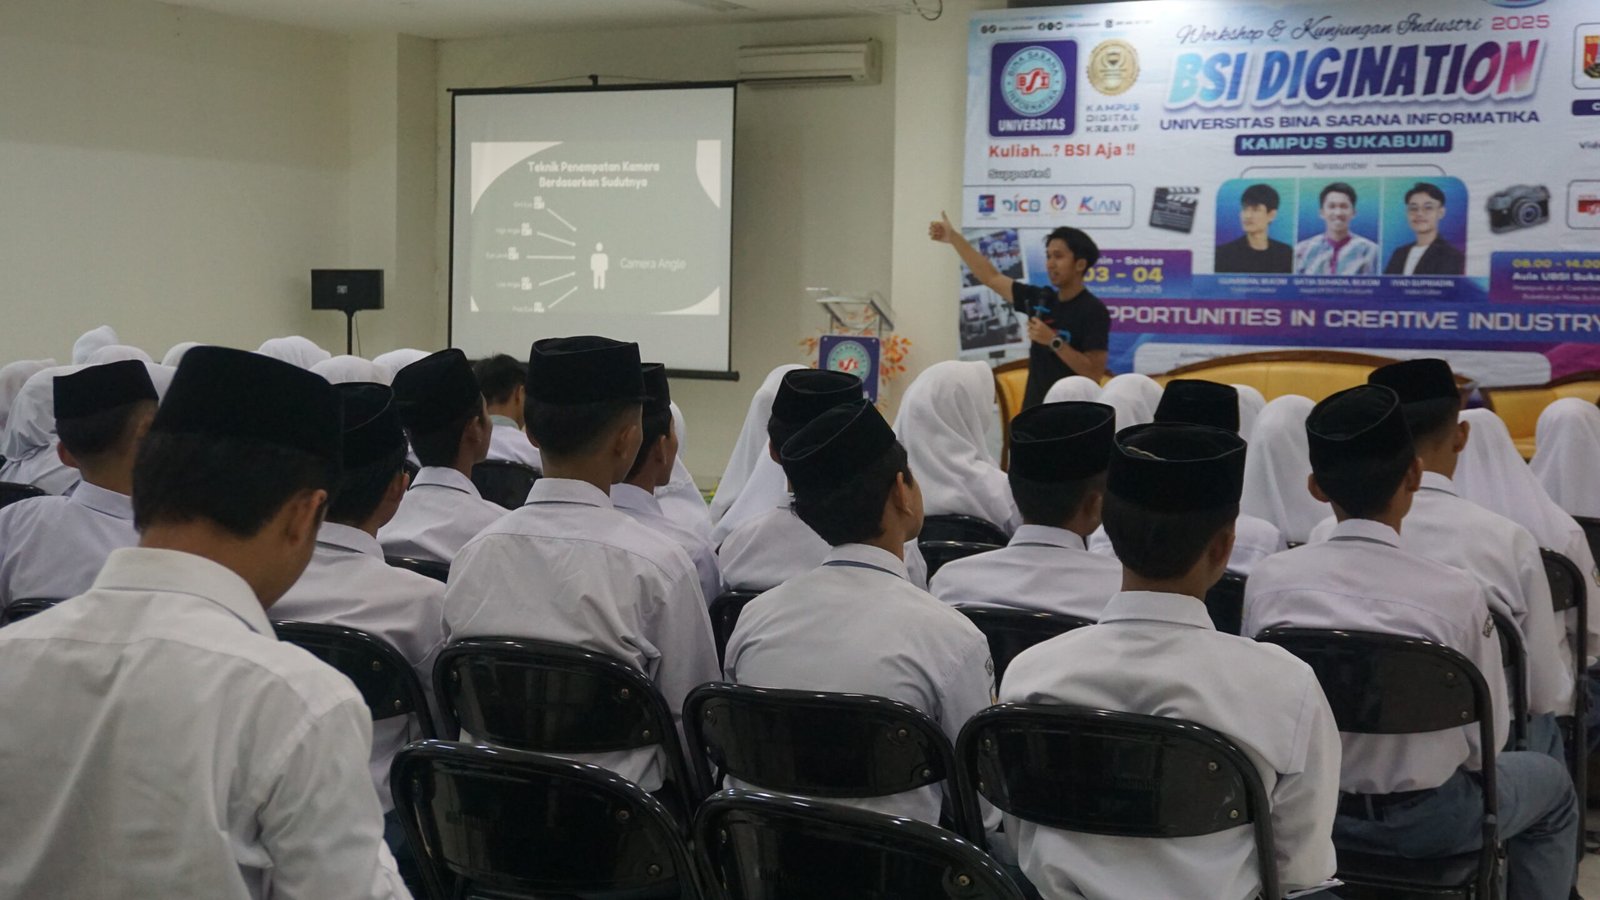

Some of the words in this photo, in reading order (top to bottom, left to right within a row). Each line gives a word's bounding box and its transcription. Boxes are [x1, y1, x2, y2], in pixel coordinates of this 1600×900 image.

[1177, 23, 1264, 44] Workshop
[1268, 20, 1286, 38] &
[1291, 16, 1396, 42] Kunjungan
[1397, 13, 1483, 36] Industri
[1491, 15, 1551, 31] 2025
[1169, 51, 1249, 104] BSI
[1255, 39, 1540, 101] DIGINATION
[1085, 103, 1141, 112] KAMPUS
[998, 118, 1067, 132] UNIVERSITAS
[1085, 114, 1138, 123] DIGITAL
[1159, 117, 1275, 131] UNIVERSITAS
[1279, 115, 1321, 129] BINA
[1326, 113, 1402, 127] SARANA
[1406, 110, 1540, 126] INFORMATIKA
[1085, 124, 1141, 133] KREATIF
[1240, 135, 1328, 151] KAMPUS
[1333, 133, 1446, 149] SUKABUMI
[1064, 143, 1091, 157] BSI
[1095, 142, 1122, 159] Aja
[528, 161, 559, 173] Teknik
[622, 160, 660, 172] Kamera
[1312, 161, 1368, 171] Narasumber
[987, 168, 1051, 181] Supported
[601, 176, 648, 190] Sudutnya
[1133, 267, 1164, 283] 04
[1106, 304, 1282, 327] PPORTUNITIES
[1290, 308, 1316, 327] IN
[1324, 309, 1459, 330] CREATIVE
